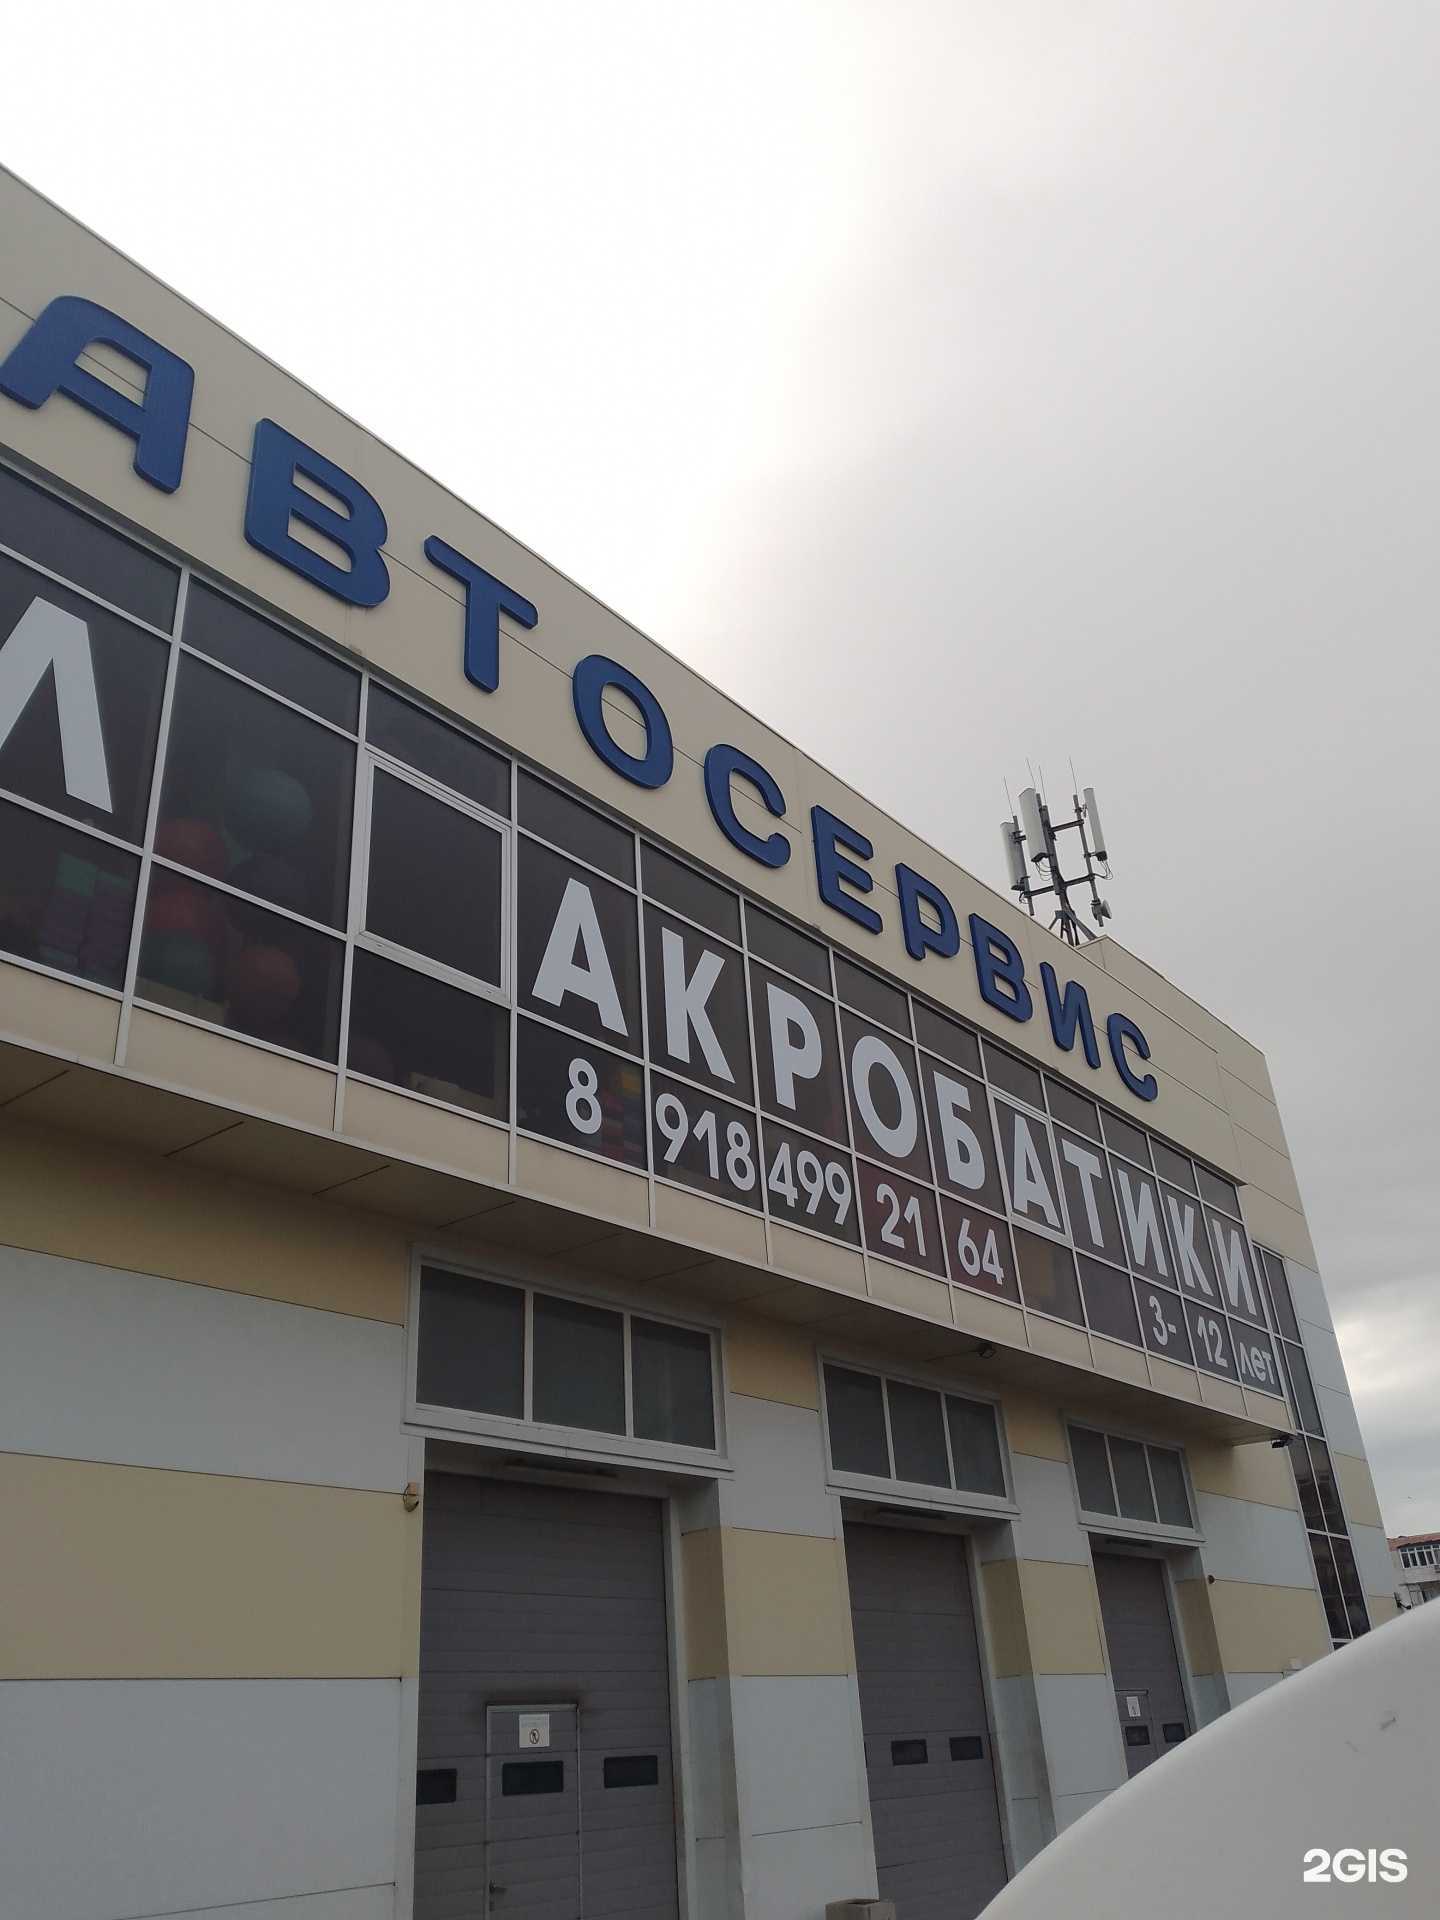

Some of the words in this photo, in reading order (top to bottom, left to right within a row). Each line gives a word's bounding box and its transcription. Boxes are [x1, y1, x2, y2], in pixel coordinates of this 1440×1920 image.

[0, 295, 1158, 1102] АВТОСЕРВИС
[531, 878, 1258, 1315] АКРОБАТИКИ
[565, 1058, 602, 1134] 8
[655, 1093, 756, 1191] 918
[768, 1142, 852, 1226] 499
[876, 1183, 927, 1257] 21
[957, 1218, 1005, 1285] 64
[1197, 1315, 1228, 1369] 12
